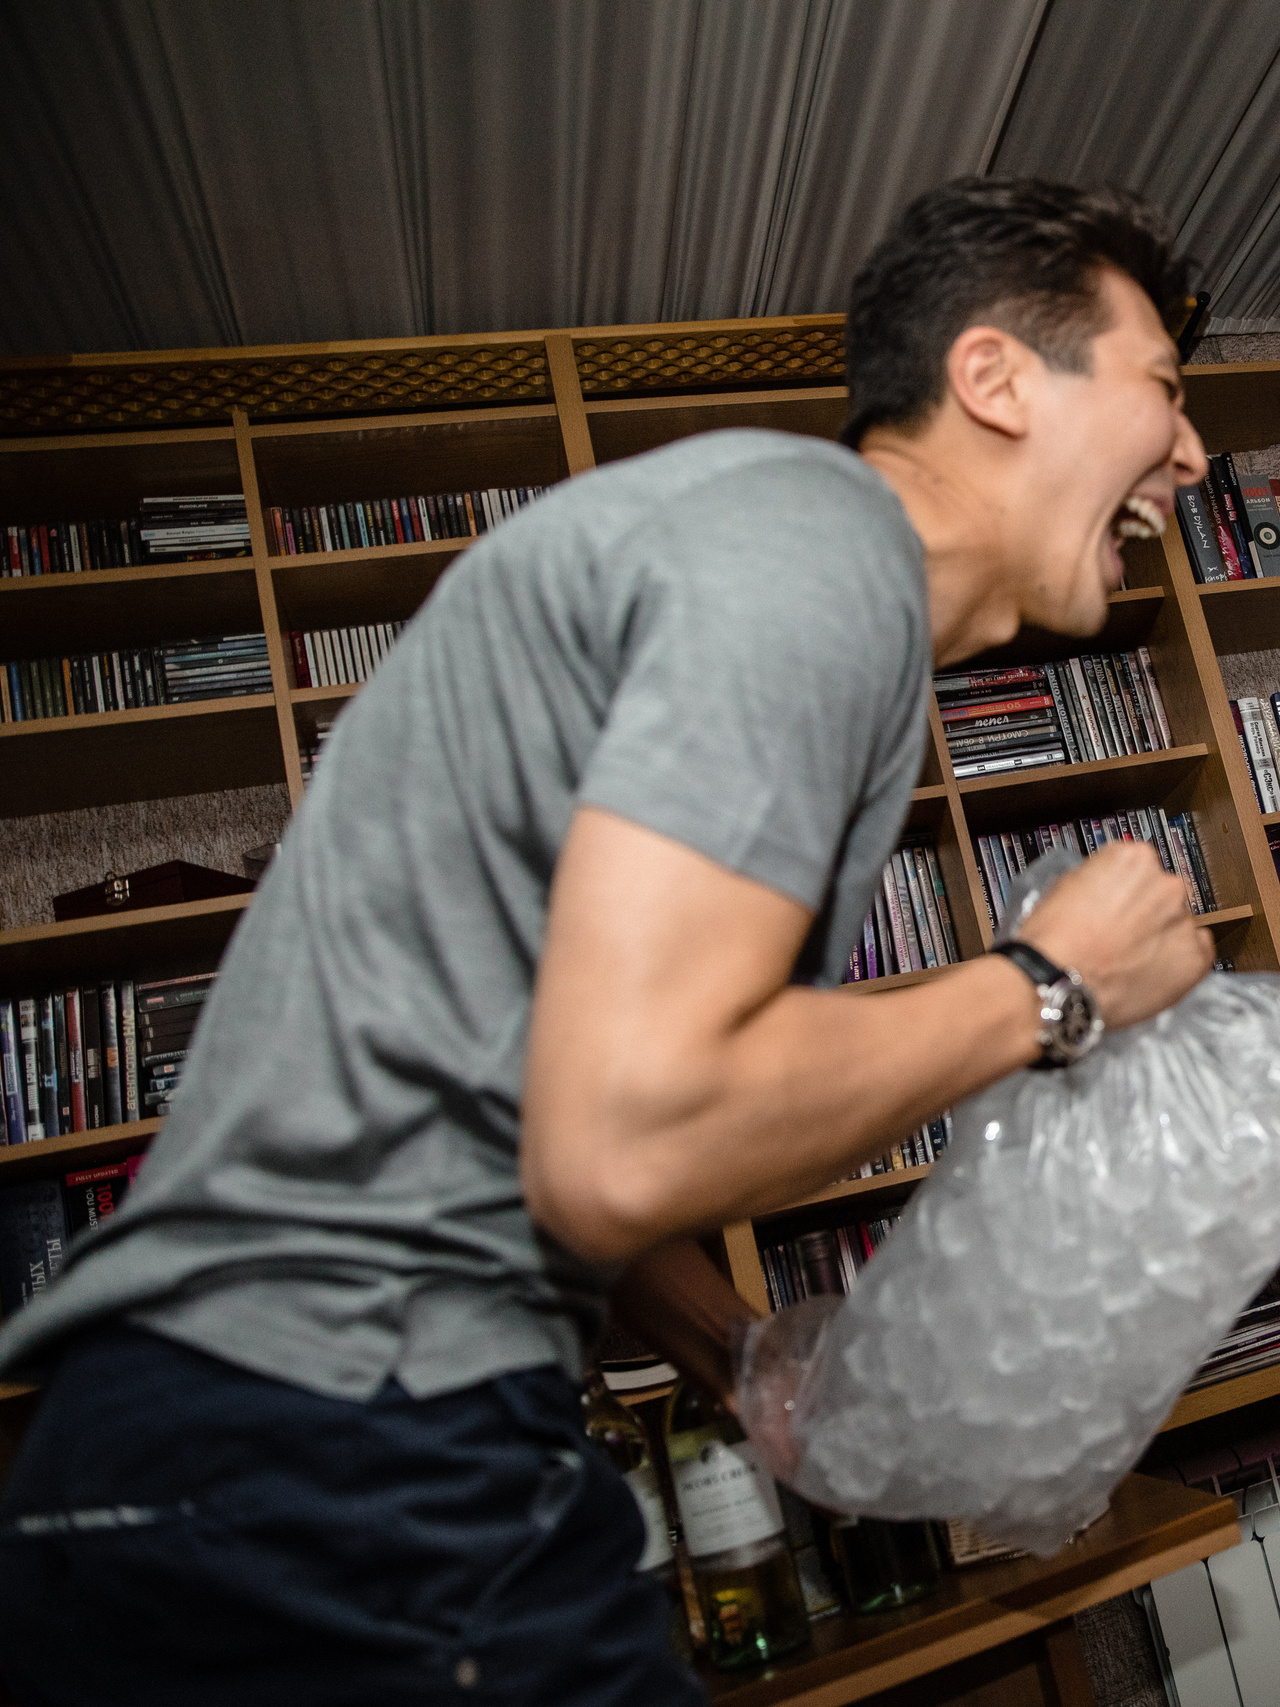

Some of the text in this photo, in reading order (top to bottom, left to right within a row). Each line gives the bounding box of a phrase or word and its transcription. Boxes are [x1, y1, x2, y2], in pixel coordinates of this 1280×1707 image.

[1243, 487, 1268, 498] 1001
[1187, 495, 1210, 549] BOB DYLAN
[1048, 669, 1074, 743] ШЕРЛОК ХОЛМС
[1095, 664, 1115, 714] JOHN WETTON
[940, 710, 968, 720] REAM
[1125, 694, 1140, 731] AUDIOSLAVE
[987, 730, 1029, 743] СМОТРИ
[75, 1169, 119, 1182] FULLY UPDATED
[86, 1187, 99, 1230] YOU MUST
[97, 1184, 115, 1216] 100
